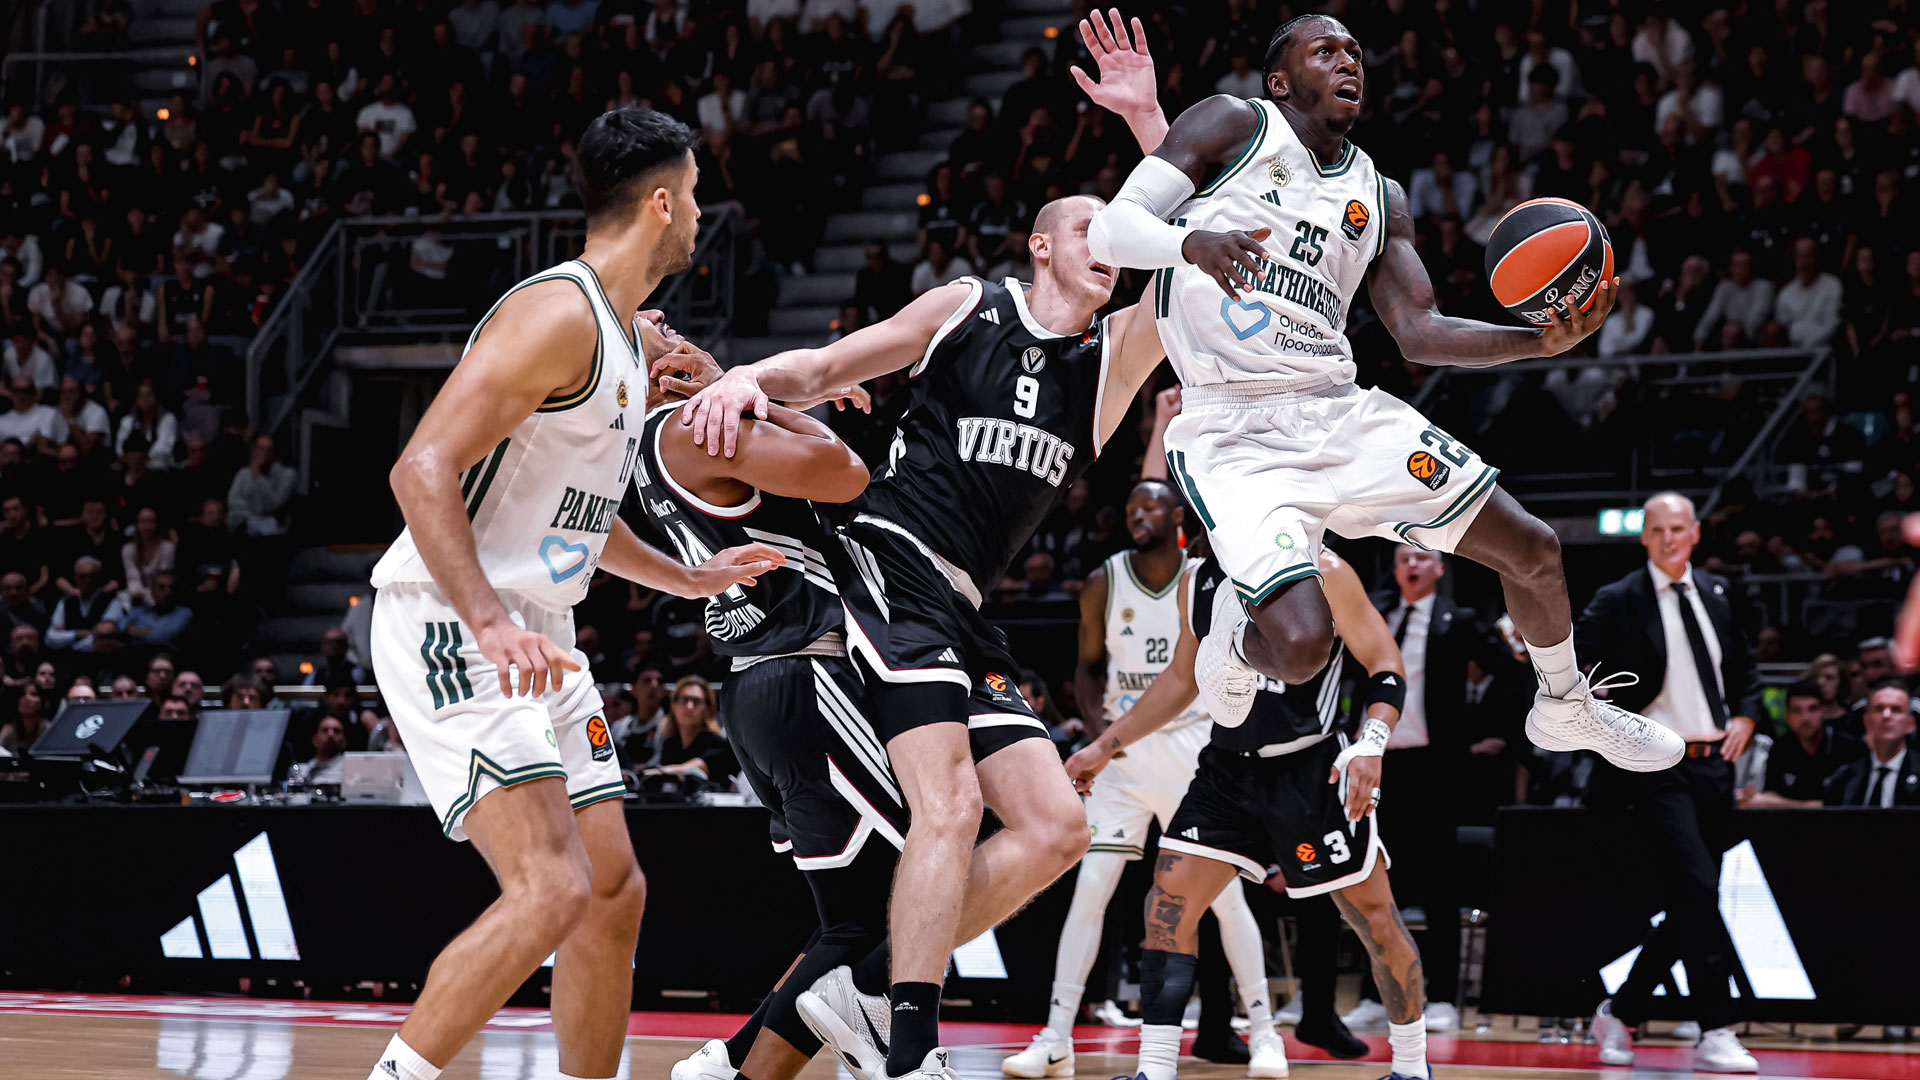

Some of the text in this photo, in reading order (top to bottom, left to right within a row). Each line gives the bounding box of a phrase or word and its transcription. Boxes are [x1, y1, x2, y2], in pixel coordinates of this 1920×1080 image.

[1289, 220, 1329, 267] 25
[1280, 315, 1324, 341] Ομάδα
[1013, 375, 1040, 419] 9
[957, 417, 1075, 487] VIRTUS
[1146, 638, 1168, 663] 22
[1323, 830, 1351, 864] 3
